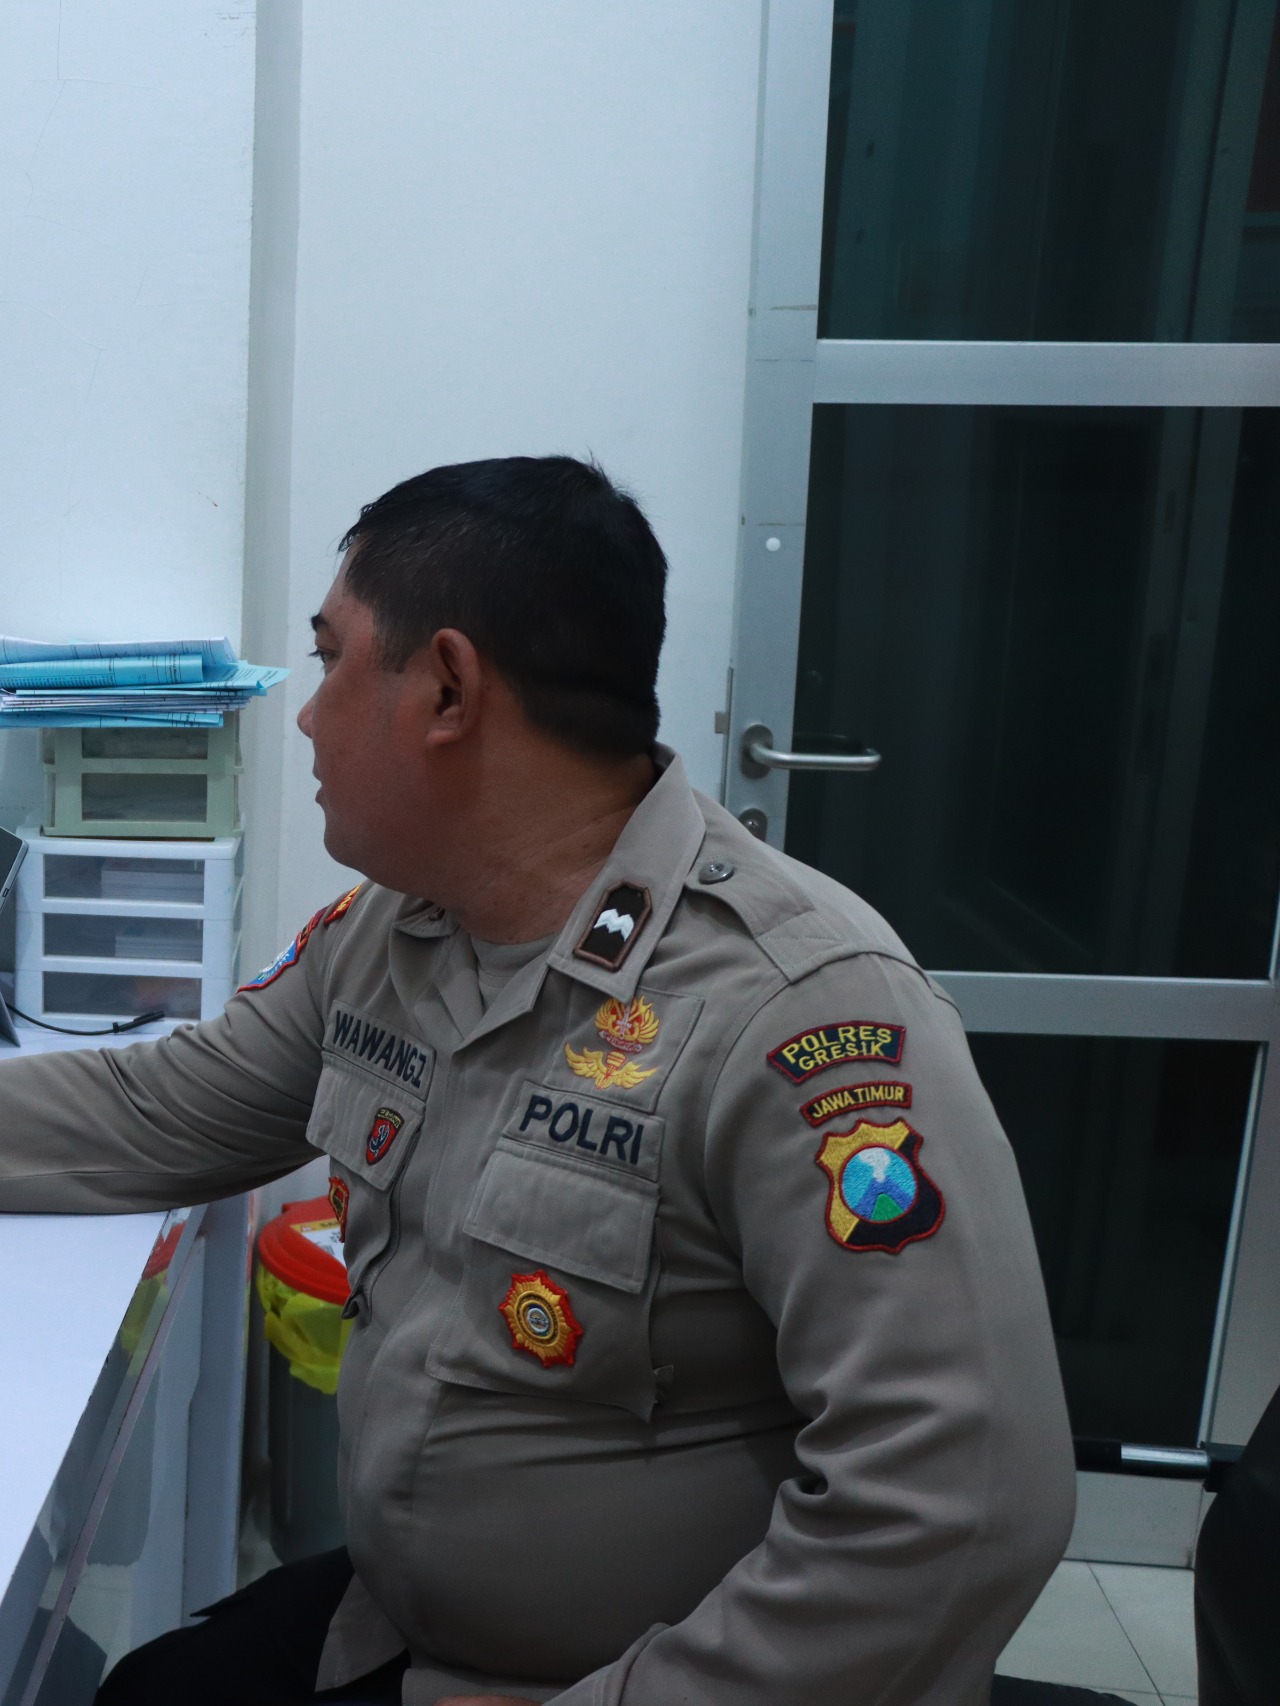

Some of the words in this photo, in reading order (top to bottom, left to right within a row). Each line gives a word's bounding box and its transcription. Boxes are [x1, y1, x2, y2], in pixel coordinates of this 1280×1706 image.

[782, 1025, 892, 1064] POLRES
[798, 1040, 885, 1071] GRESIK
[812, 1090, 855, 1118] JAWA
[853, 1085, 905, 1104] TIMUR
[519, 1094, 645, 1165] POLRI
